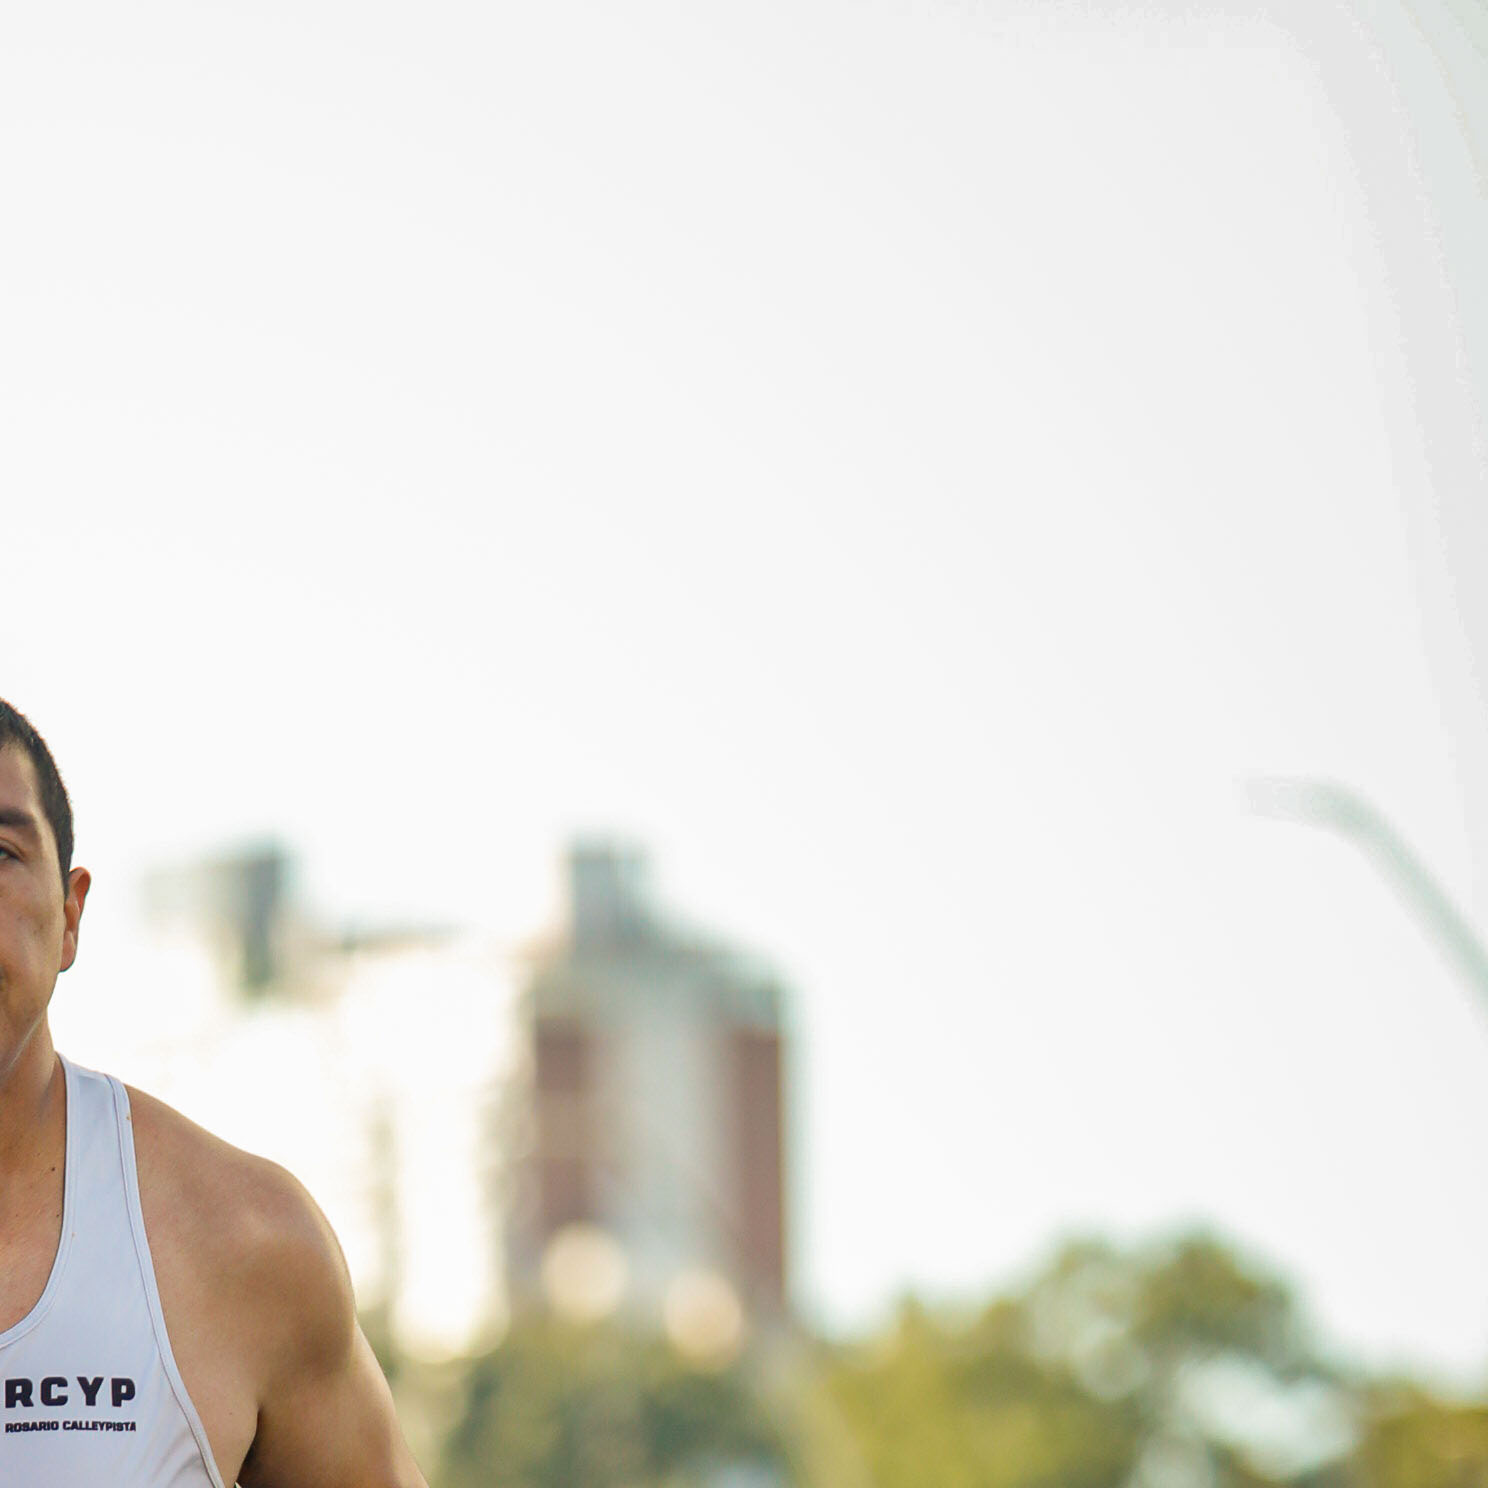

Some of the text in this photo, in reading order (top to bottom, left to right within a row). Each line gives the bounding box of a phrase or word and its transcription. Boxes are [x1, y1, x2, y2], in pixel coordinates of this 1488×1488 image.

[5, 1376, 136, 1408] RCYP
[5, 1420, 136, 1433] ROSARIO CALLEYPISTA
